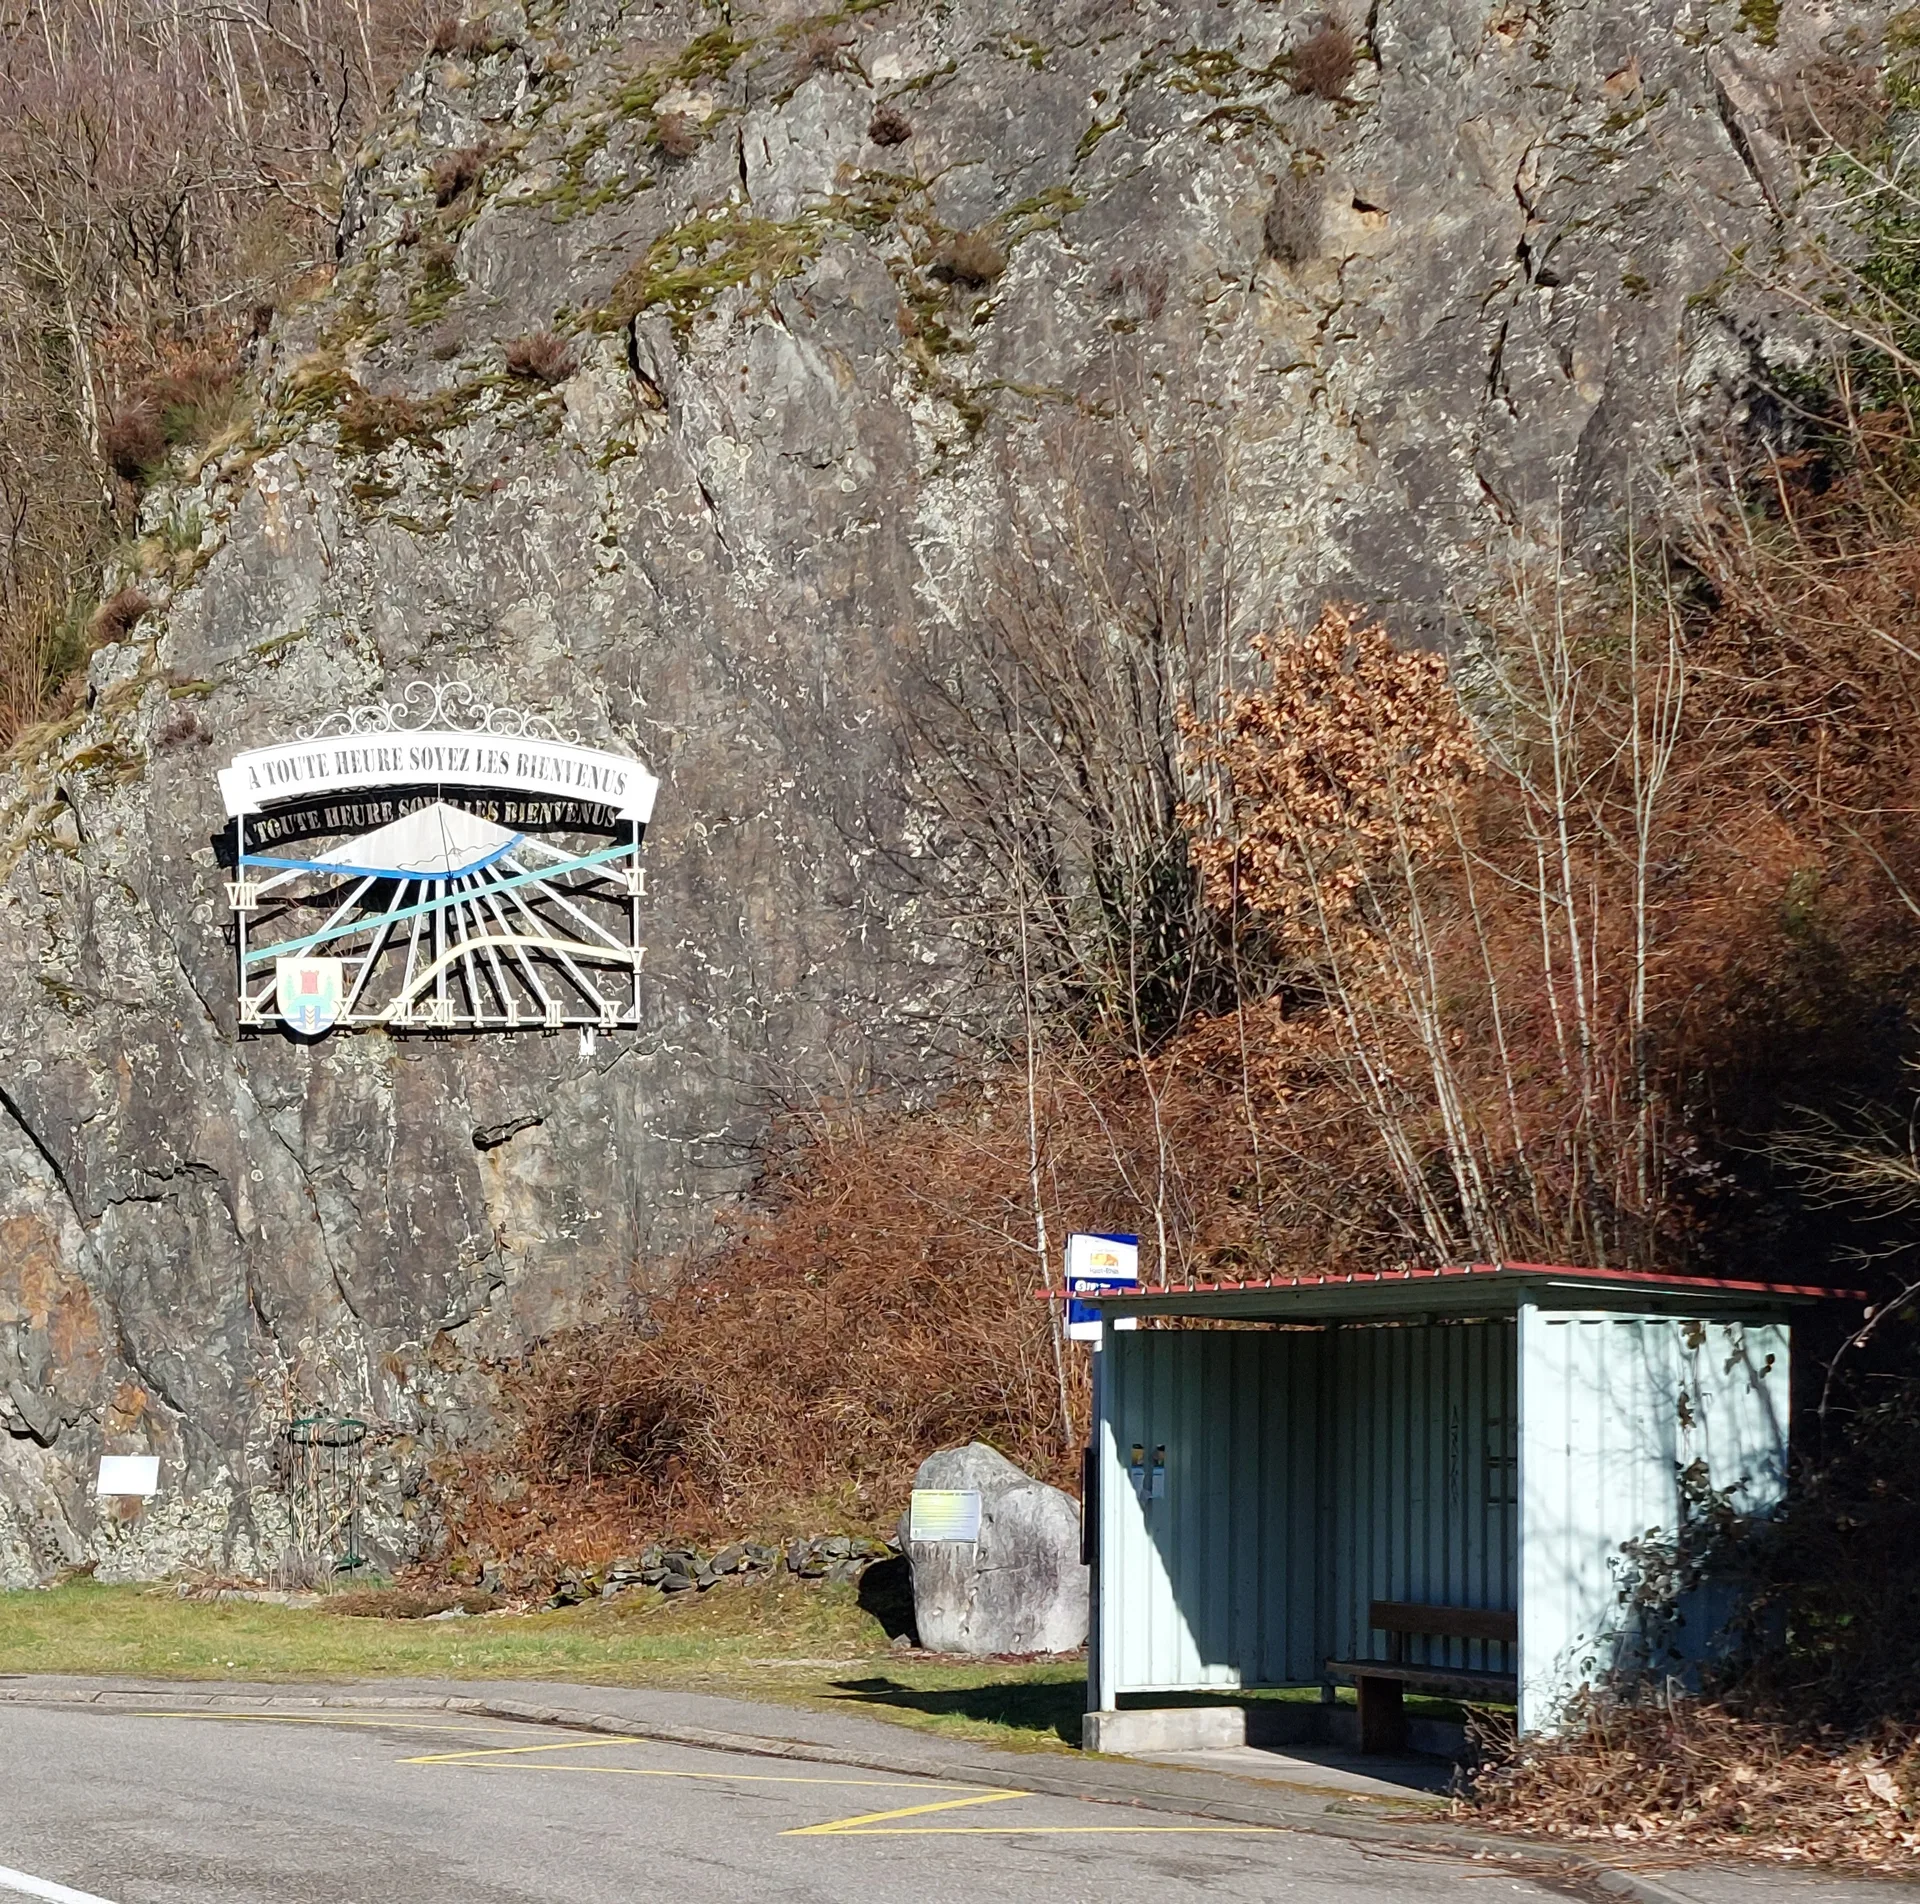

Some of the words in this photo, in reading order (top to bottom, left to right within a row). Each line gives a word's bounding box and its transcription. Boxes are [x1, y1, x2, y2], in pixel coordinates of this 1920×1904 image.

[248, 766, 262, 790] A
[263, 752, 329, 786] TOUTE
[334, 748, 403, 775] HEURE
[409, 746, 470, 772] SOYEZ
[475, 749, 511, 775] LES
[516, 752, 628, 796] BIENVENUS
[252, 809, 321, 843] TOUTE
[324, 801, 394, 828] HEURE
[503, 801, 616, 828] BIENVENUS
[224, 882, 259, 910] VIII
[622, 868, 648, 896] VI
[627, 947, 649, 975] V
[237, 997, 264, 1025] IX
[334, 998, 356, 1025] X
[388, 998, 415, 1026] XI
[425, 998, 456, 1027] XII
[505, 999, 520, 1027] II
[543, 999, 564, 1028] III
[599, 1000, 623, 1028] IV
